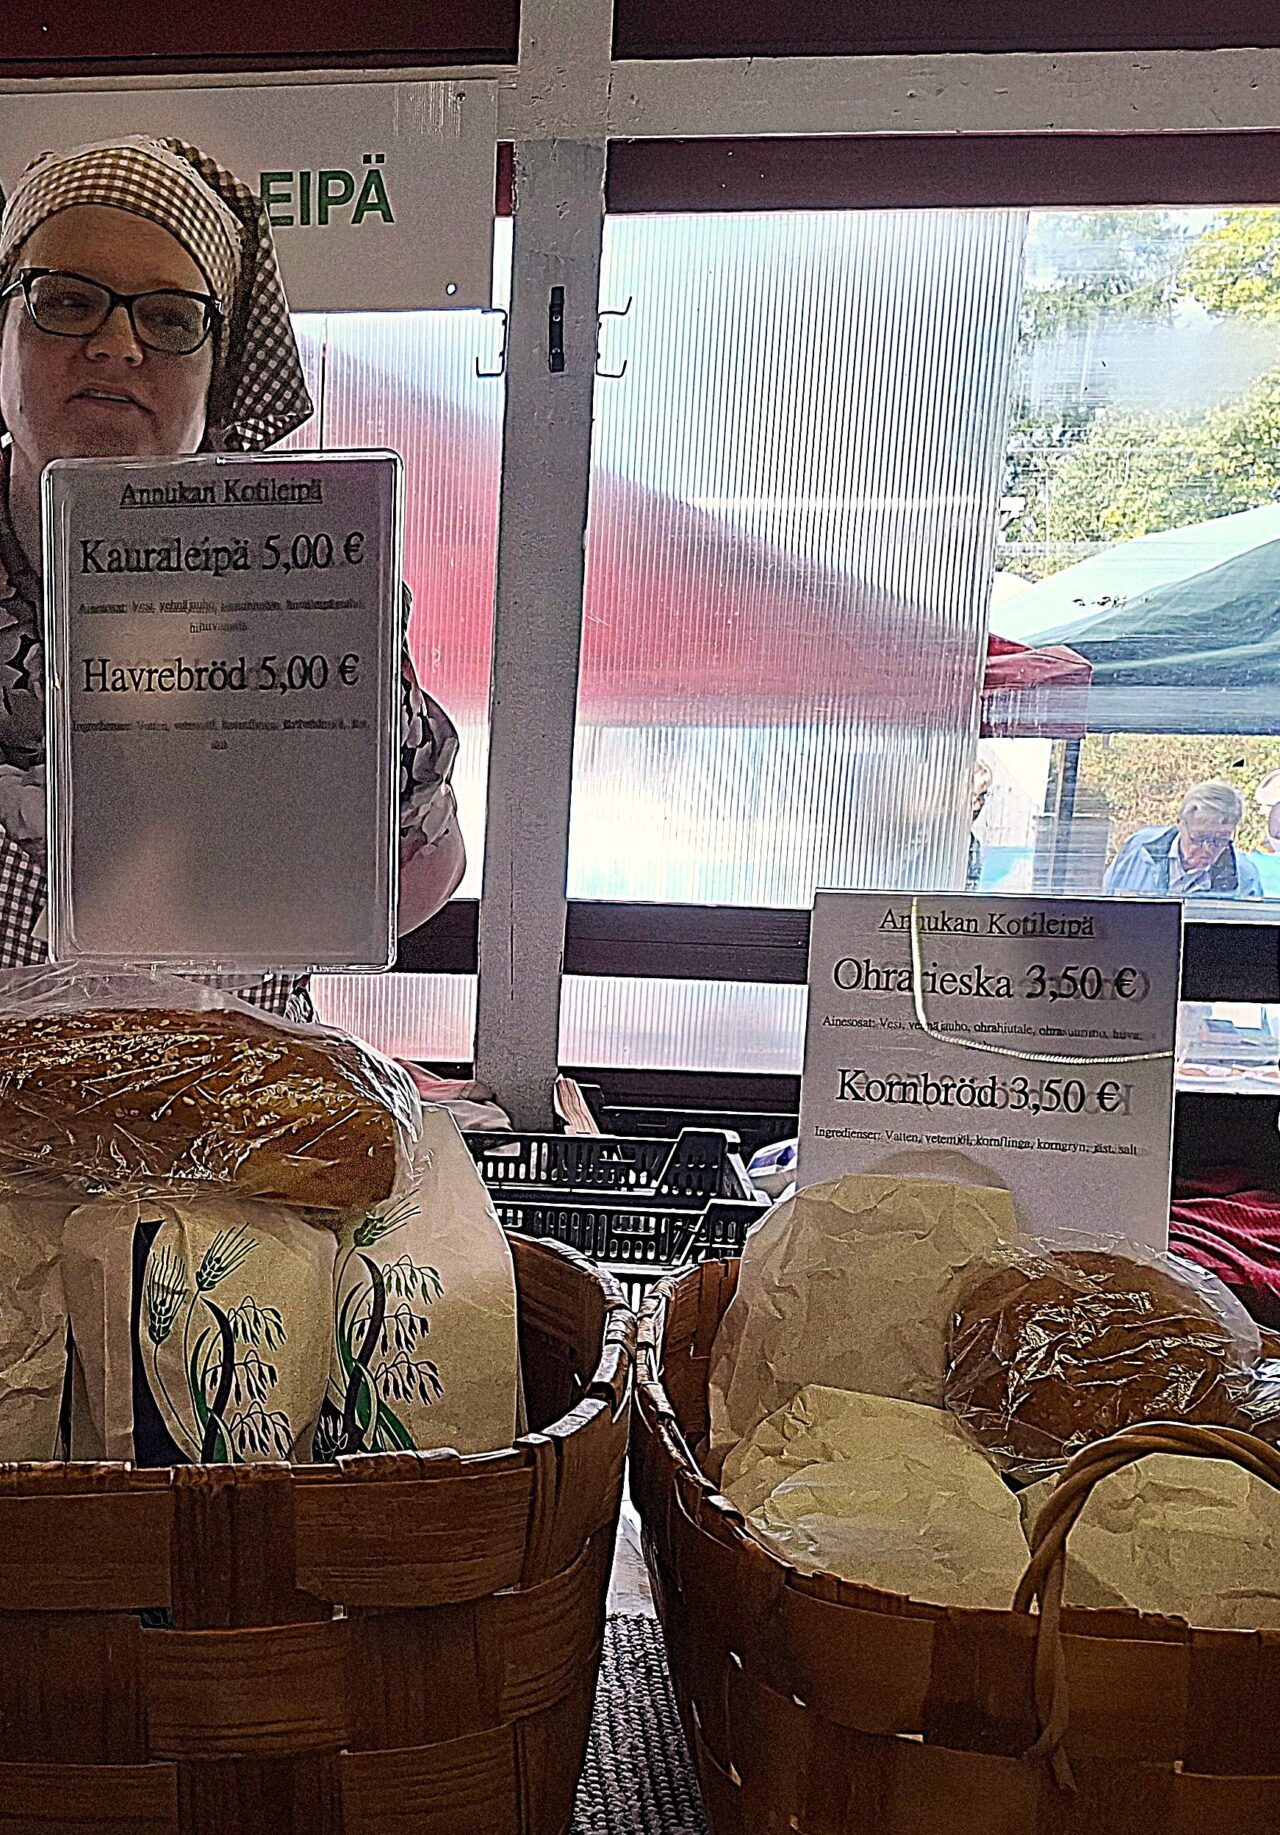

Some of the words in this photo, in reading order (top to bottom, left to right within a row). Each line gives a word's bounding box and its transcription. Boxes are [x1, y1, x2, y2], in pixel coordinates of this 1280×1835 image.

[260, 154, 395, 226] EIPÄ
[121, 481, 216, 505] Annukan
[223, 478, 323, 503] Kotileipä
[79, 535, 252, 577] Kauraleipä
[261, 533, 334, 575] 5,00
[342, 531, 366, 566] €
[82, 656, 248, 692] Havrebröd
[258, 655, 329, 695] 5,00
[338, 653, 361, 687] €
[986, 911, 1095, 938] Kotileipä
[1025, 965, 1103, 1003] 3,50
[1113, 967, 1138, 999] €
[908, 1020, 971, 1033] venäjauho,
[836, 1068, 1000, 1108] Kornbröd
[1008, 1077, 1086, 1116] 3,50
[1096, 1080, 1121, 1112] €
